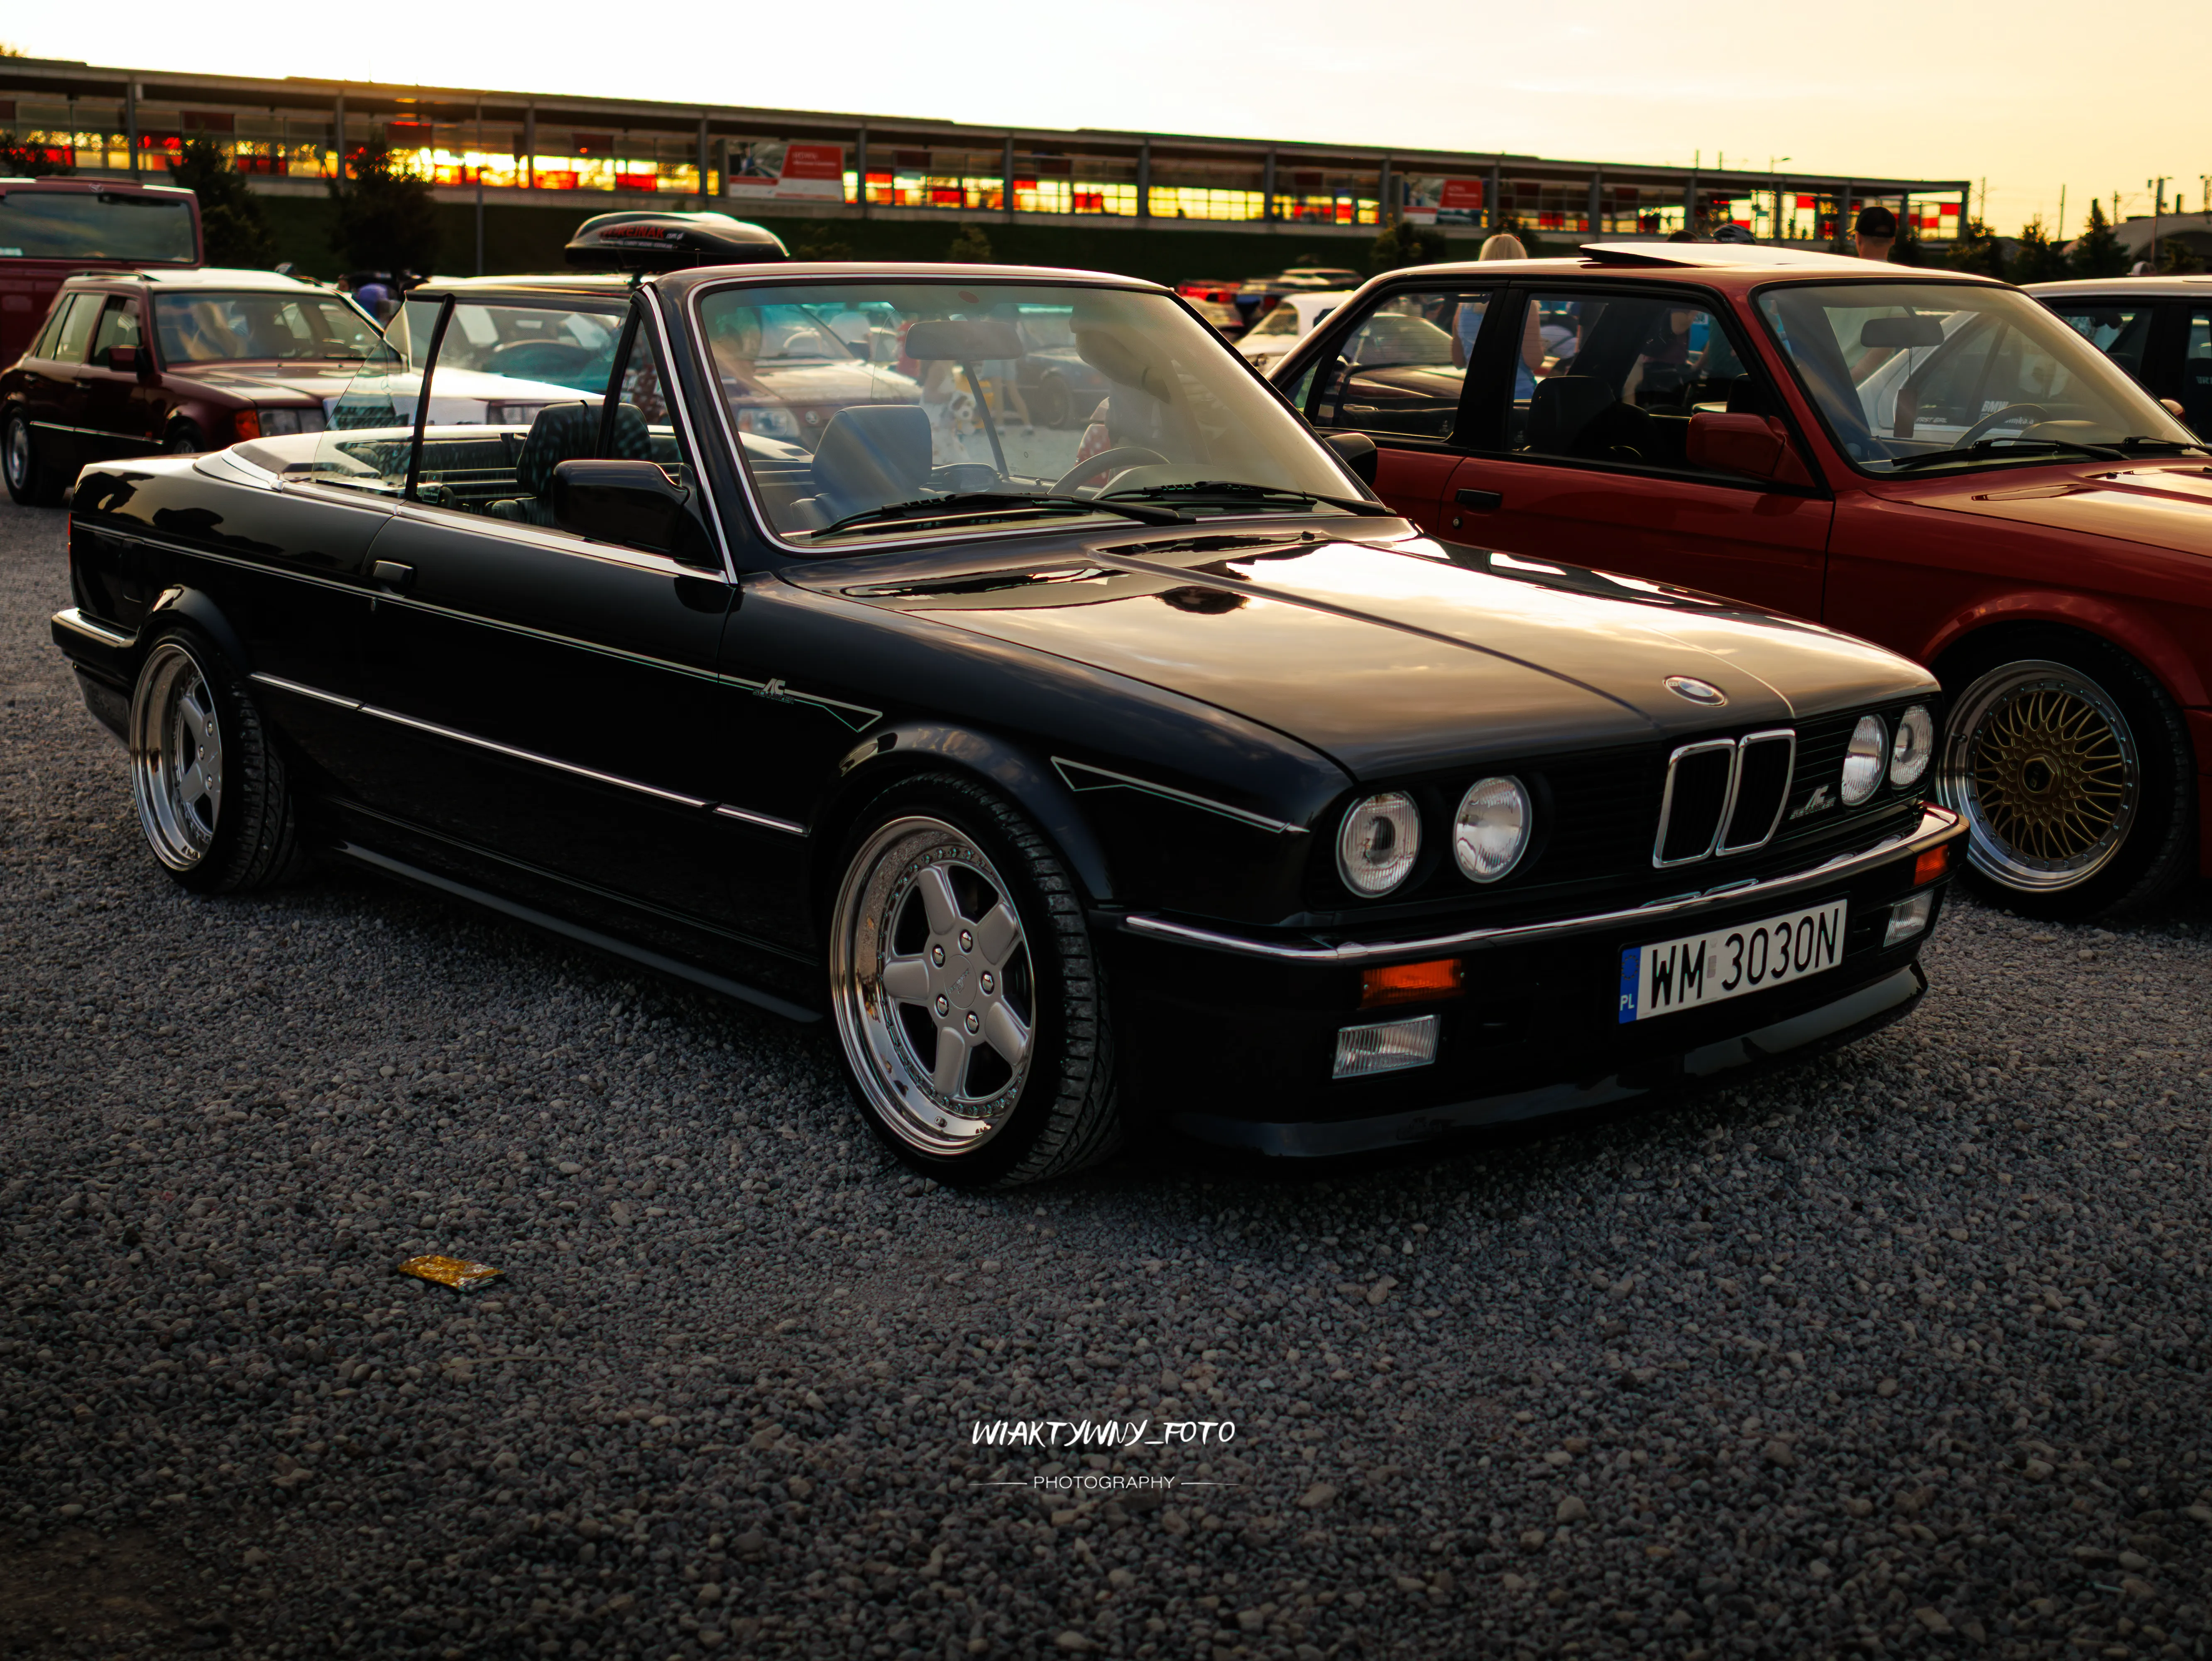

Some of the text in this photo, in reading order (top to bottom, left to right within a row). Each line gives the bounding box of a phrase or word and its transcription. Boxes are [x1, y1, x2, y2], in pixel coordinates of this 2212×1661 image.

[1981, 401, 2009, 412] BMW
[763, 678, 785, 696] AC
[1651, 908, 1839, 1009] WM 3030N
[1620, 993, 1635, 1011] PL
